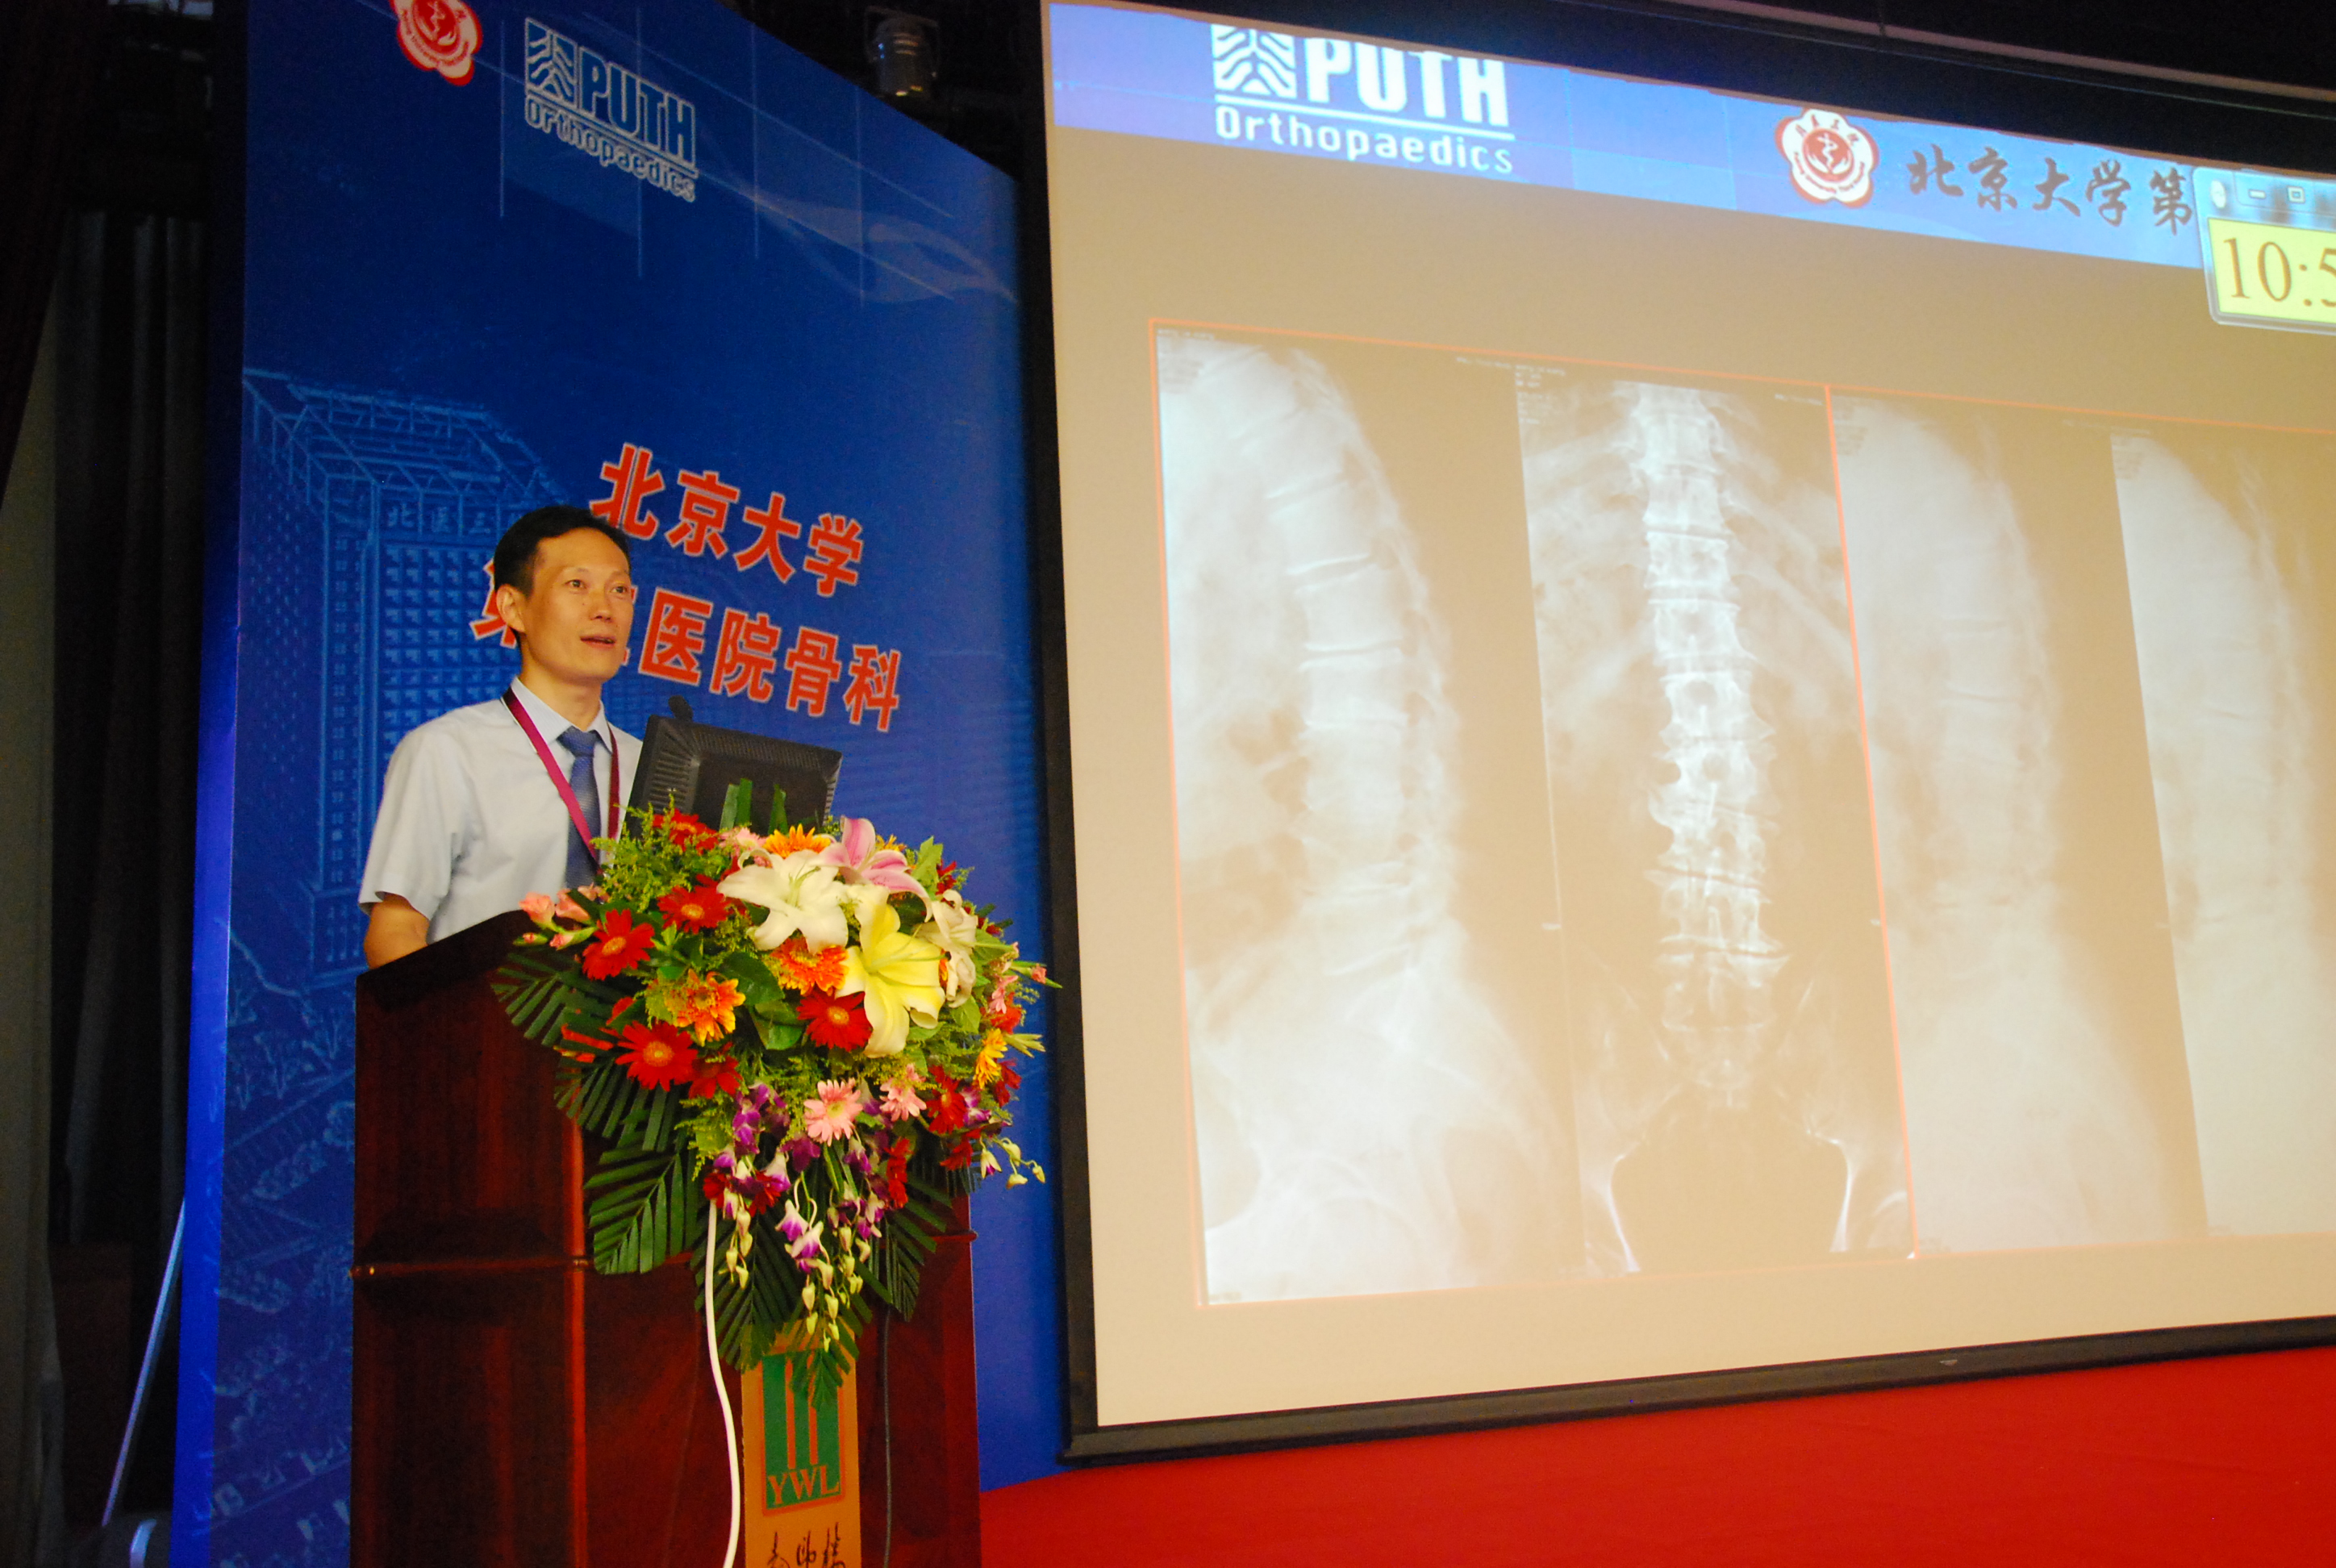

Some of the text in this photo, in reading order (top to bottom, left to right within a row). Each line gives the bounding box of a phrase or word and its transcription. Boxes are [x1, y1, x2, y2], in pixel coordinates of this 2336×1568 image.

[578, 45, 696, 168] PUTH
[1304, 37, 1508, 127] PUTH
[525, 94, 696, 202] Orthopaedics
[1216, 106, 1513, 173] Orthopaedics
[1906, 144, 2194, 236] 北京大学第
[589, 441, 864, 597] 北京大学
[470, 557, 902, 732] 医院骨科
[767, 1465, 840, 1505] YWL
